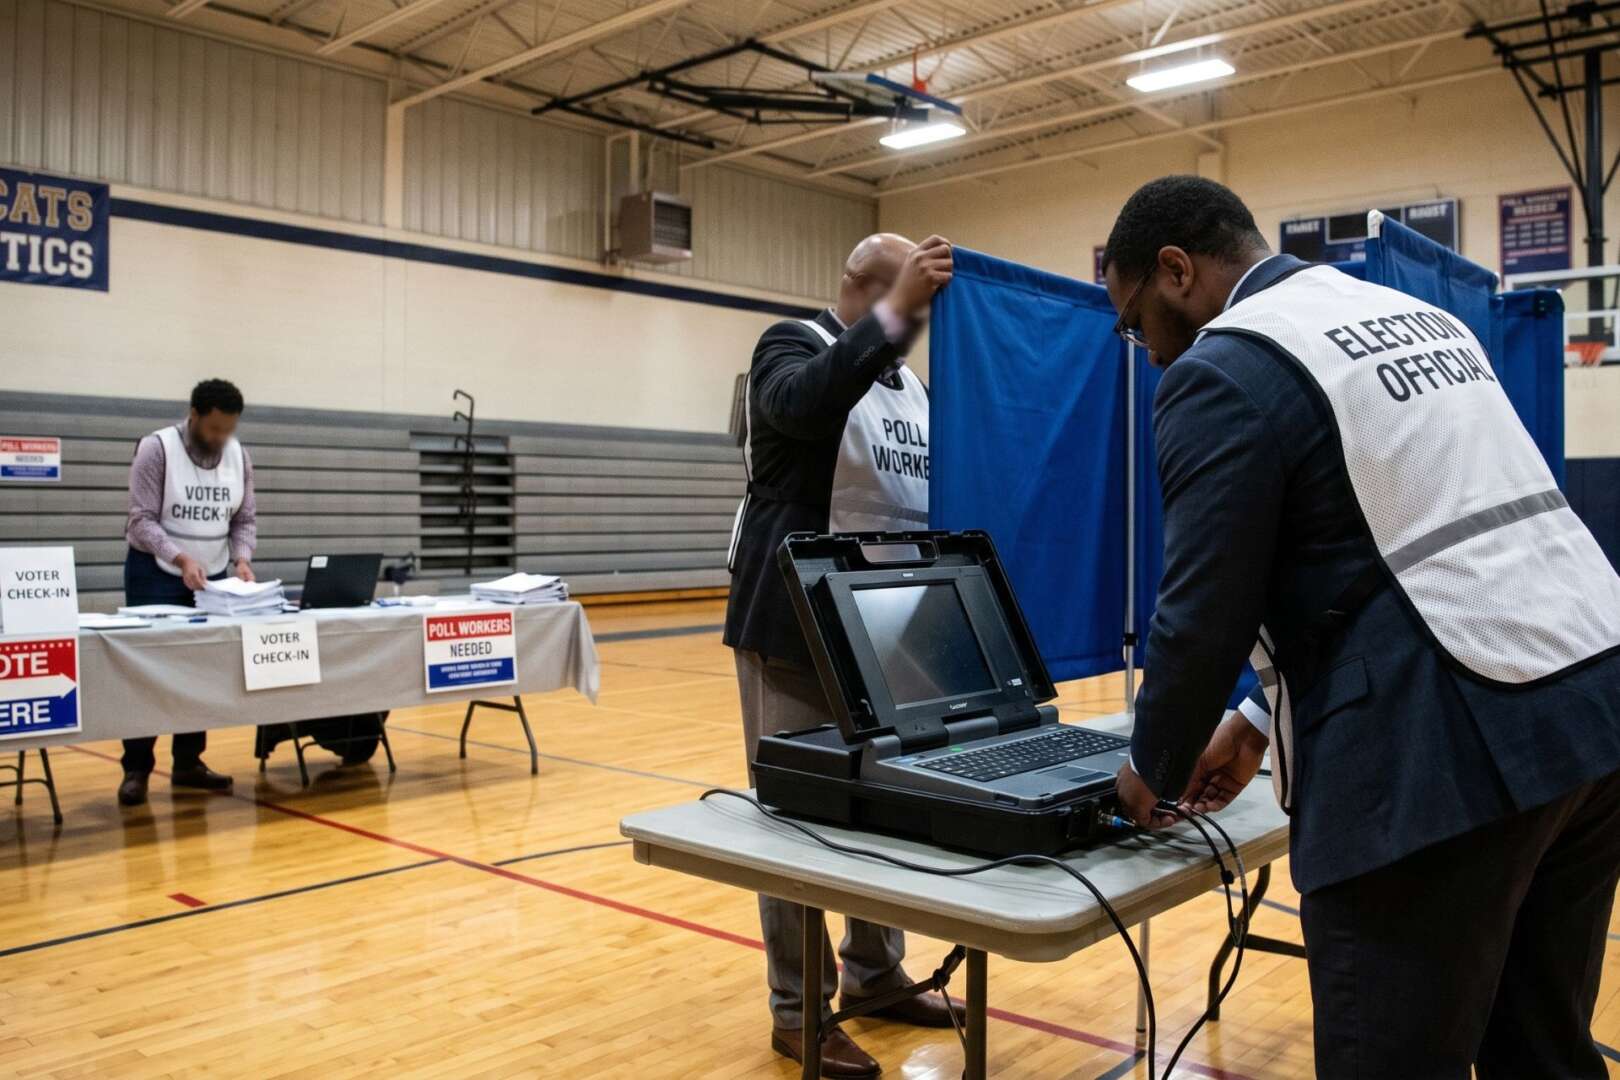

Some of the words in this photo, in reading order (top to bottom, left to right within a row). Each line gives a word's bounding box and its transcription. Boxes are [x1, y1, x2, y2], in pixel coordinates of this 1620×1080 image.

[0, 231, 93, 279] TICS
[1323, 311, 1466, 361] ELECTION
[1376, 347, 1495, 402] OFFICIAL
[882, 418, 927, 448] POLL
[185, 486, 231, 502] VOTER
[15, 570, 60, 582] VOTER
[7, 587, 70, 600] CHECK-IN
[428, 622, 457, 638] POLL
[458, 618, 510, 635] WORKERS
[260, 632, 300, 645] VOTER
[252, 649, 309, 665] CHECK-IN
[450, 641, 492, 657] NEEDED
